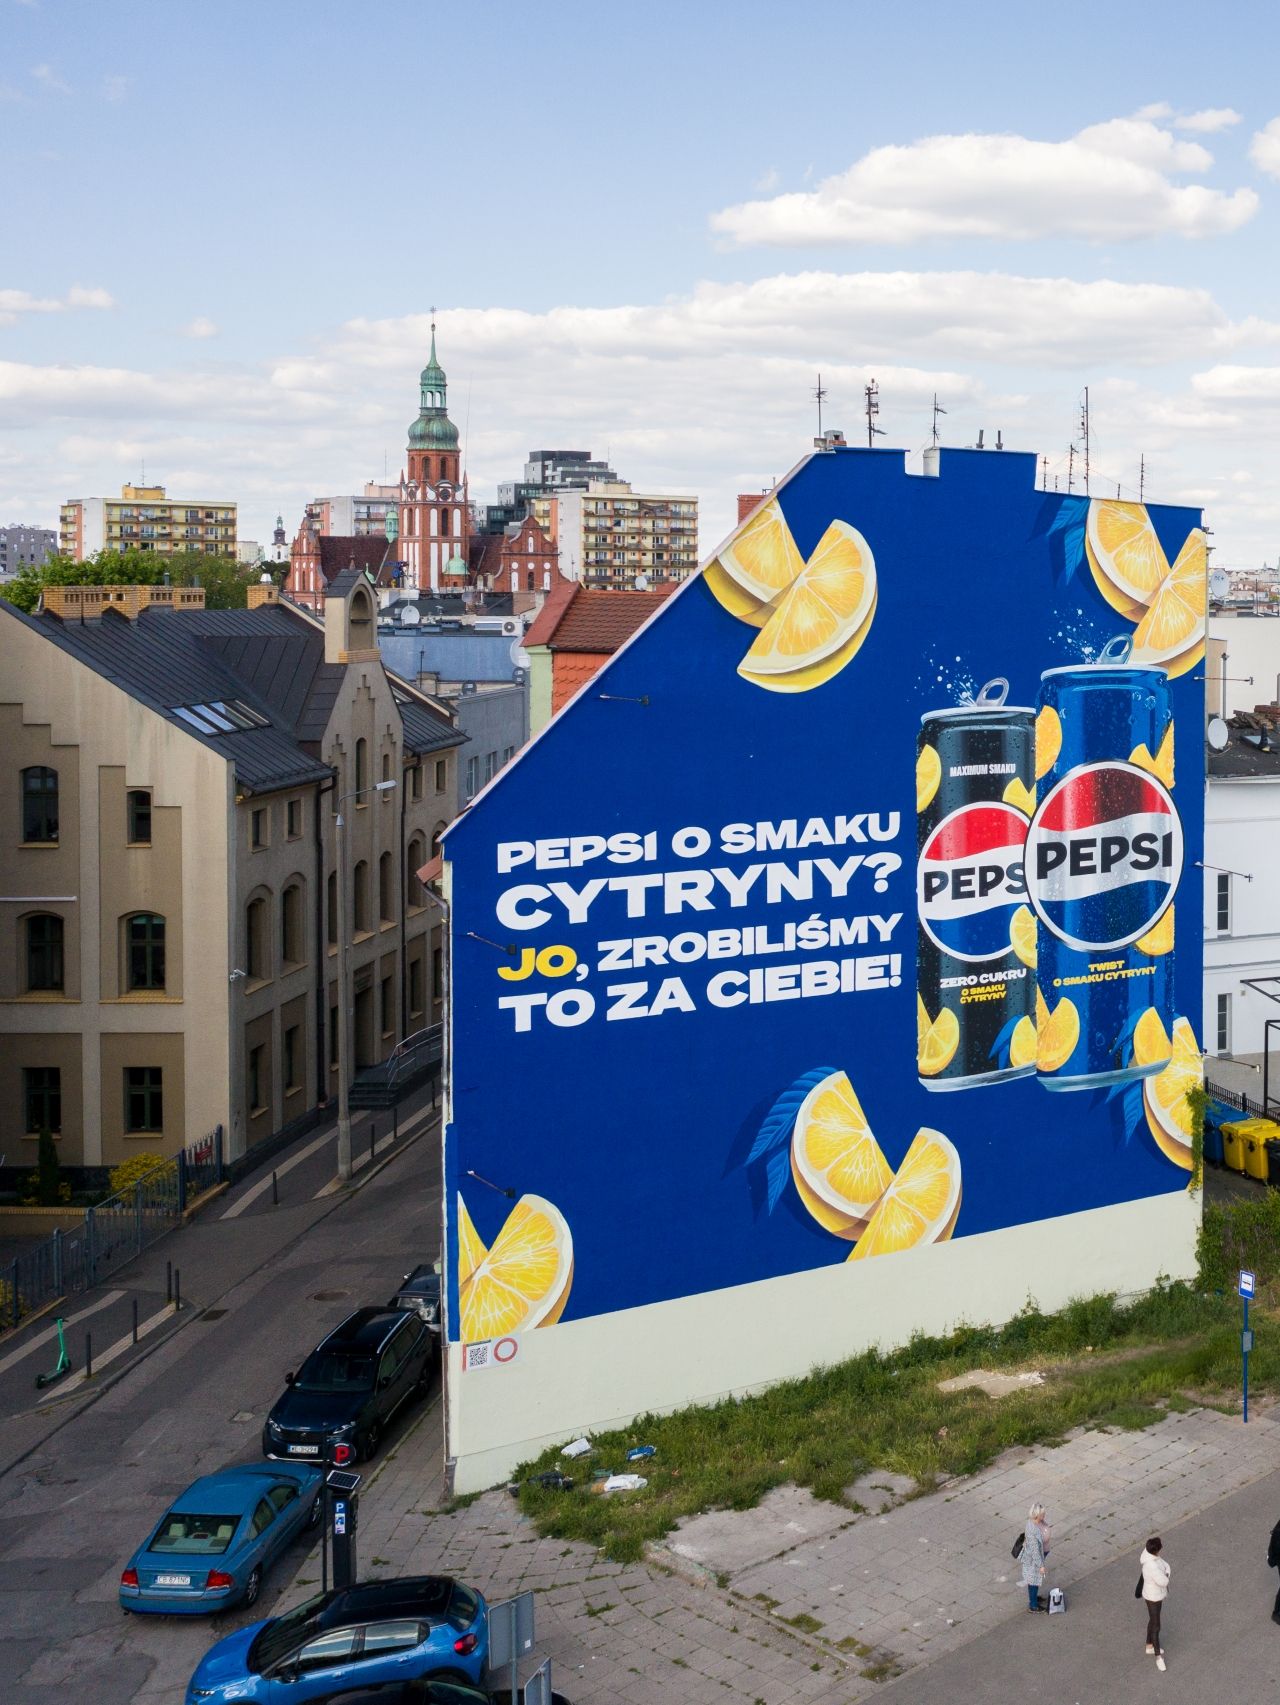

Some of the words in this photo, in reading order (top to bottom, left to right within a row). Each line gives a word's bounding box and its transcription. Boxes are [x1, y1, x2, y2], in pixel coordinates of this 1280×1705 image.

[950, 764, 988, 777] MAXIMUM
[989, 763, 1016, 774] SMAKU
[498, 831, 657, 874] PEPSI
[671, 826, 711, 858] O
[720, 811, 901, 854] SMAKU
[1037, 831, 1172, 880] PEPSI
[496, 852, 902, 931] CYTRYNY?
[923, 862, 1027, 903] PEPS
[497, 944, 590, 982] JO,
[597, 912, 903, 972] ZROBILIŚMY
[1053, 978, 1062, 987] O
[1062, 973, 1104, 986] SMAKU
[1104, 966, 1157, 981] CYTRYNY
[1088, 960, 1125, 972] TWIST
[940, 975, 977, 989] ZERO
[979, 968, 1027, 984] CUKRU
[498, 988, 595, 1033] TO
[606, 977, 696, 1021] ZA
[706, 953, 902, 1009] CIEBIE!
[960, 991, 1007, 1005] CYTRYNY
[961, 988, 969, 996] O
[970, 983, 1006, 995] SMAKU
[336, 1446, 350, 1464] P
[336, 1503, 344, 1512] P
